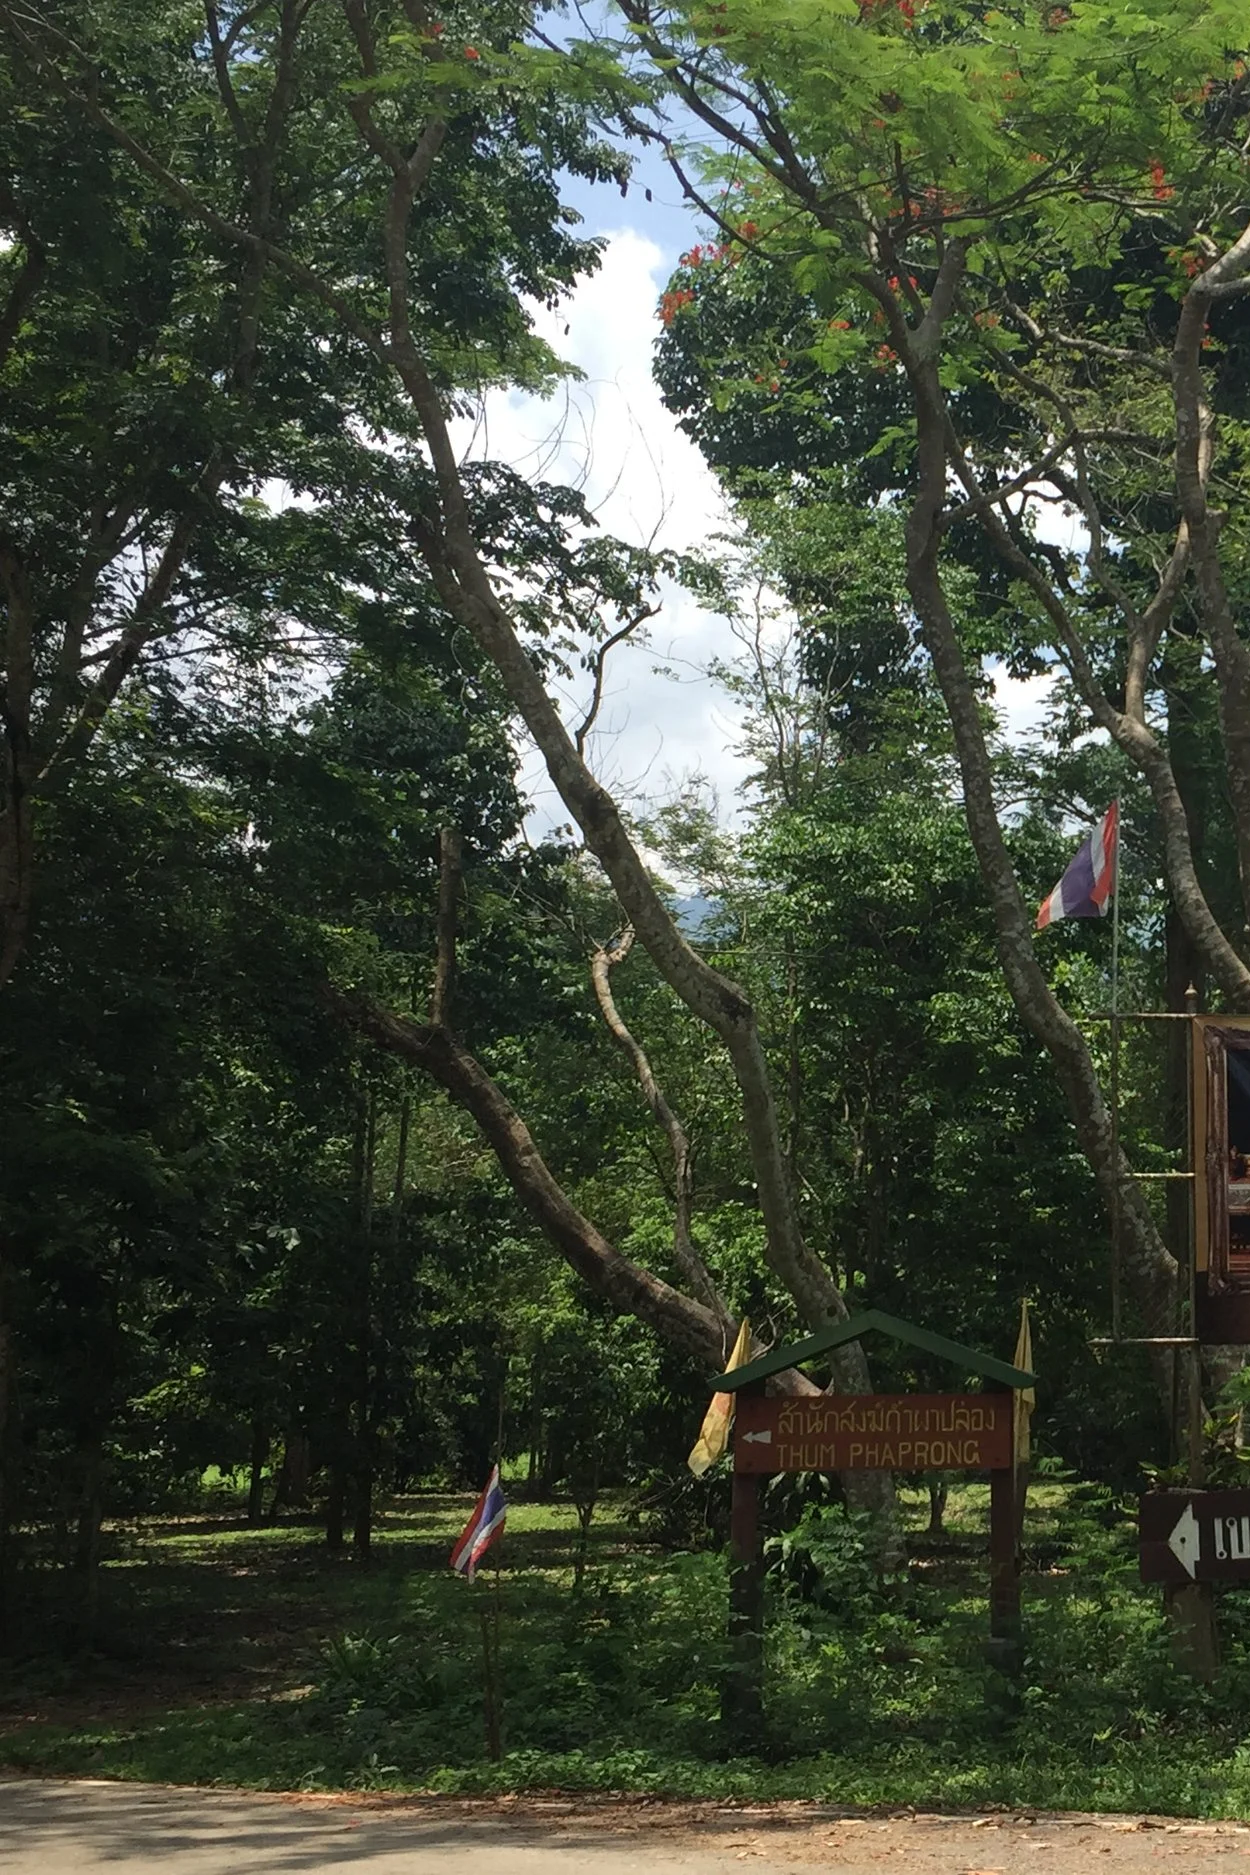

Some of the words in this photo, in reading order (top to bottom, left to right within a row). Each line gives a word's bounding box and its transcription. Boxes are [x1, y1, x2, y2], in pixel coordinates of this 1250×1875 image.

[777, 1400, 995, 1435] สำนักสงฆ์ถ้ำผาปล่อง
[776, 1443, 835, 1468] THUM
[849, 1440, 981, 1468] PHAPRONG
